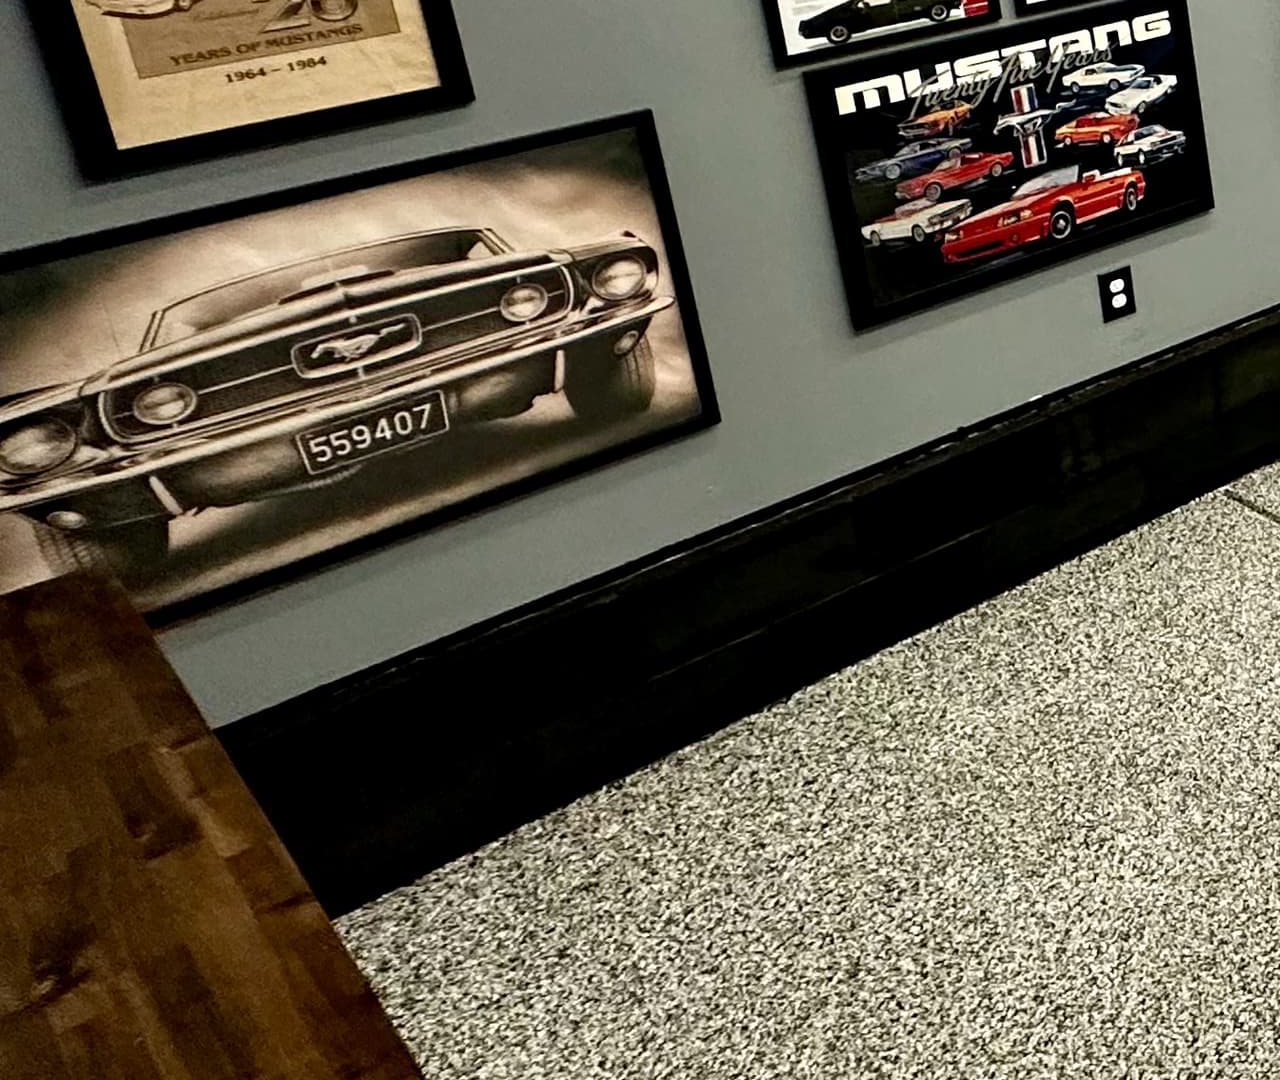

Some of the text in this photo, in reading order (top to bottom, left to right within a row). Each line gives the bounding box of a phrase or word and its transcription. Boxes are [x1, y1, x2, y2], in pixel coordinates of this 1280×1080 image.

[169, 23, 364, 66] YEARS OF MUSTANGS
[225, 67, 267, 84] 1964
[286, 56, 328, 72] 1984
[834, 10, 1172, 116] MUSTANG
[308, 403, 432, 462] 559407
